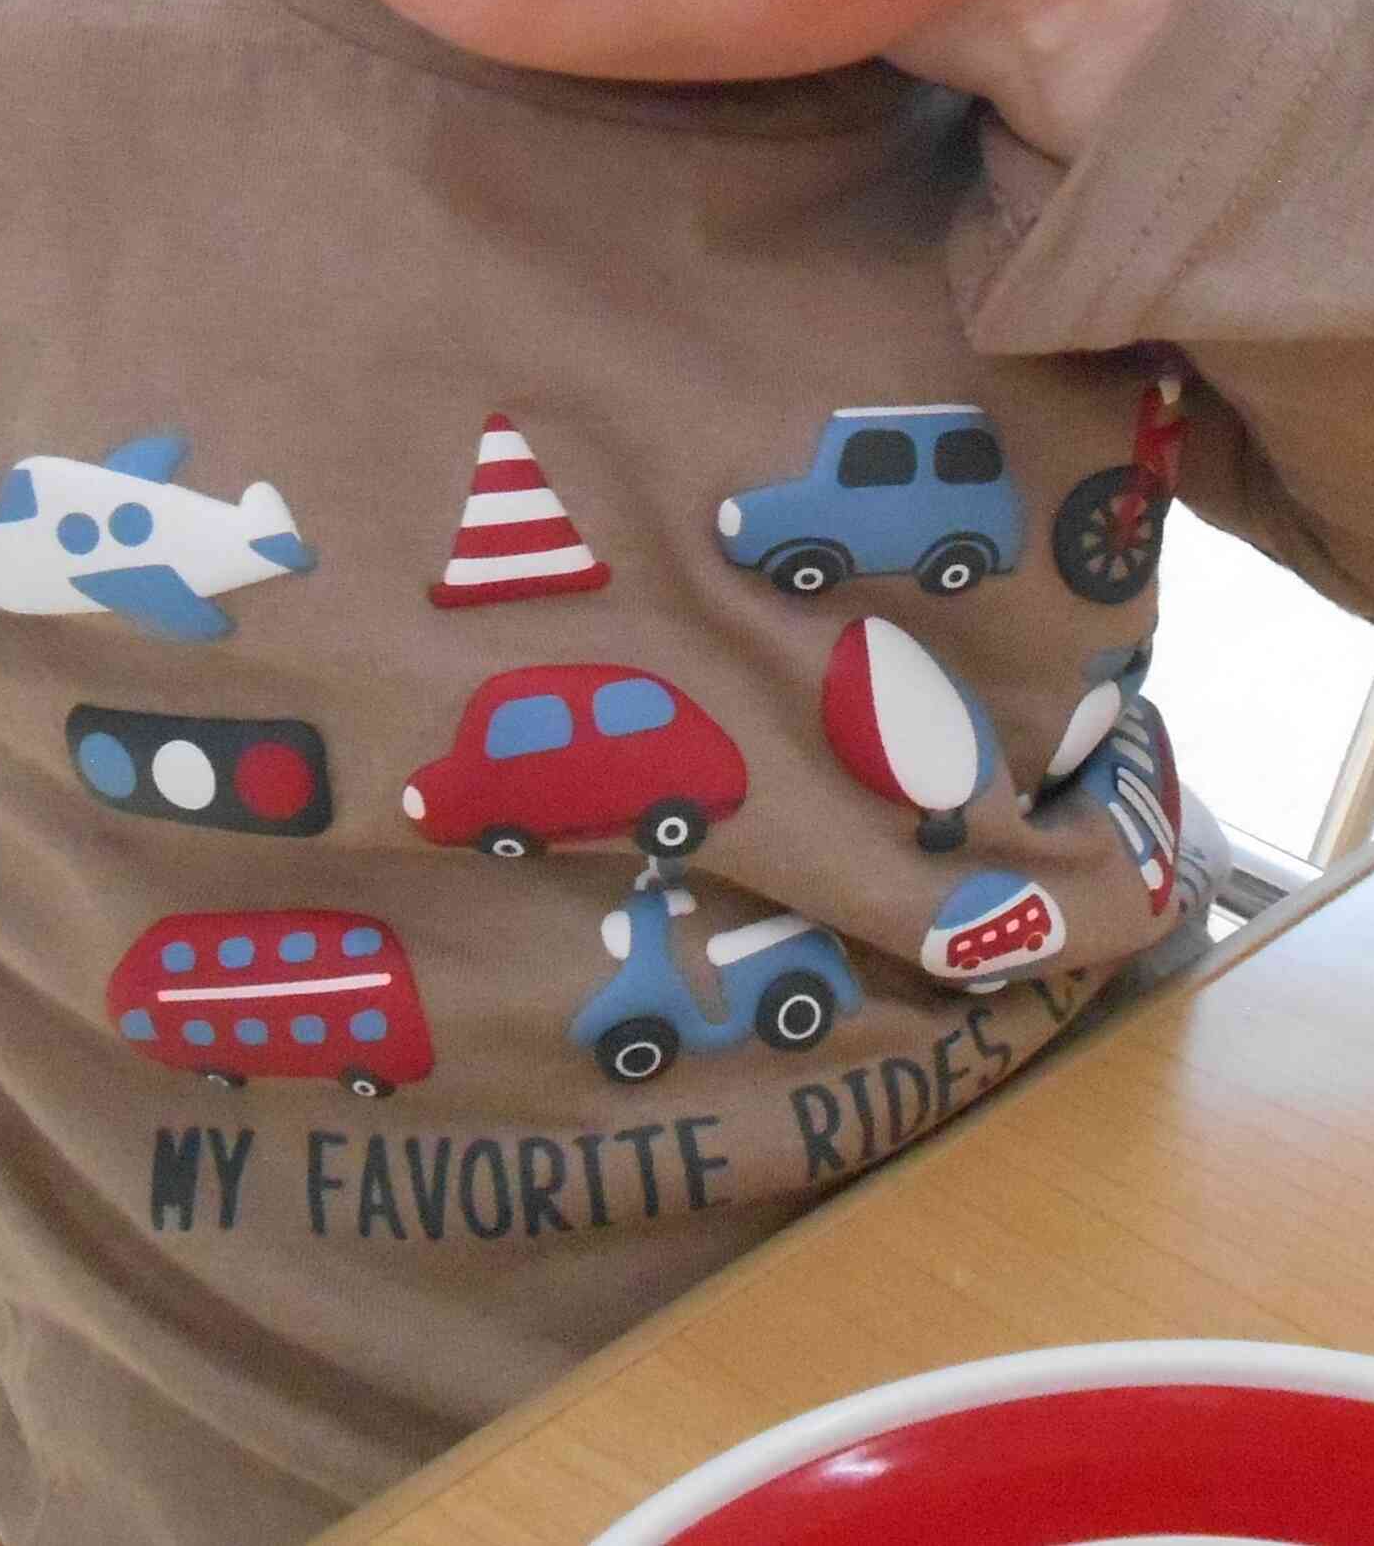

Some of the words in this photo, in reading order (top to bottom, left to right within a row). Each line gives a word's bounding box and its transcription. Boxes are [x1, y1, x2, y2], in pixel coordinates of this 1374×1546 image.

[149, 1126, 255, 1234] MY
[306, 1114, 730, 1242] FAVORITE
[790, 1005, 1013, 1182] RIDES
